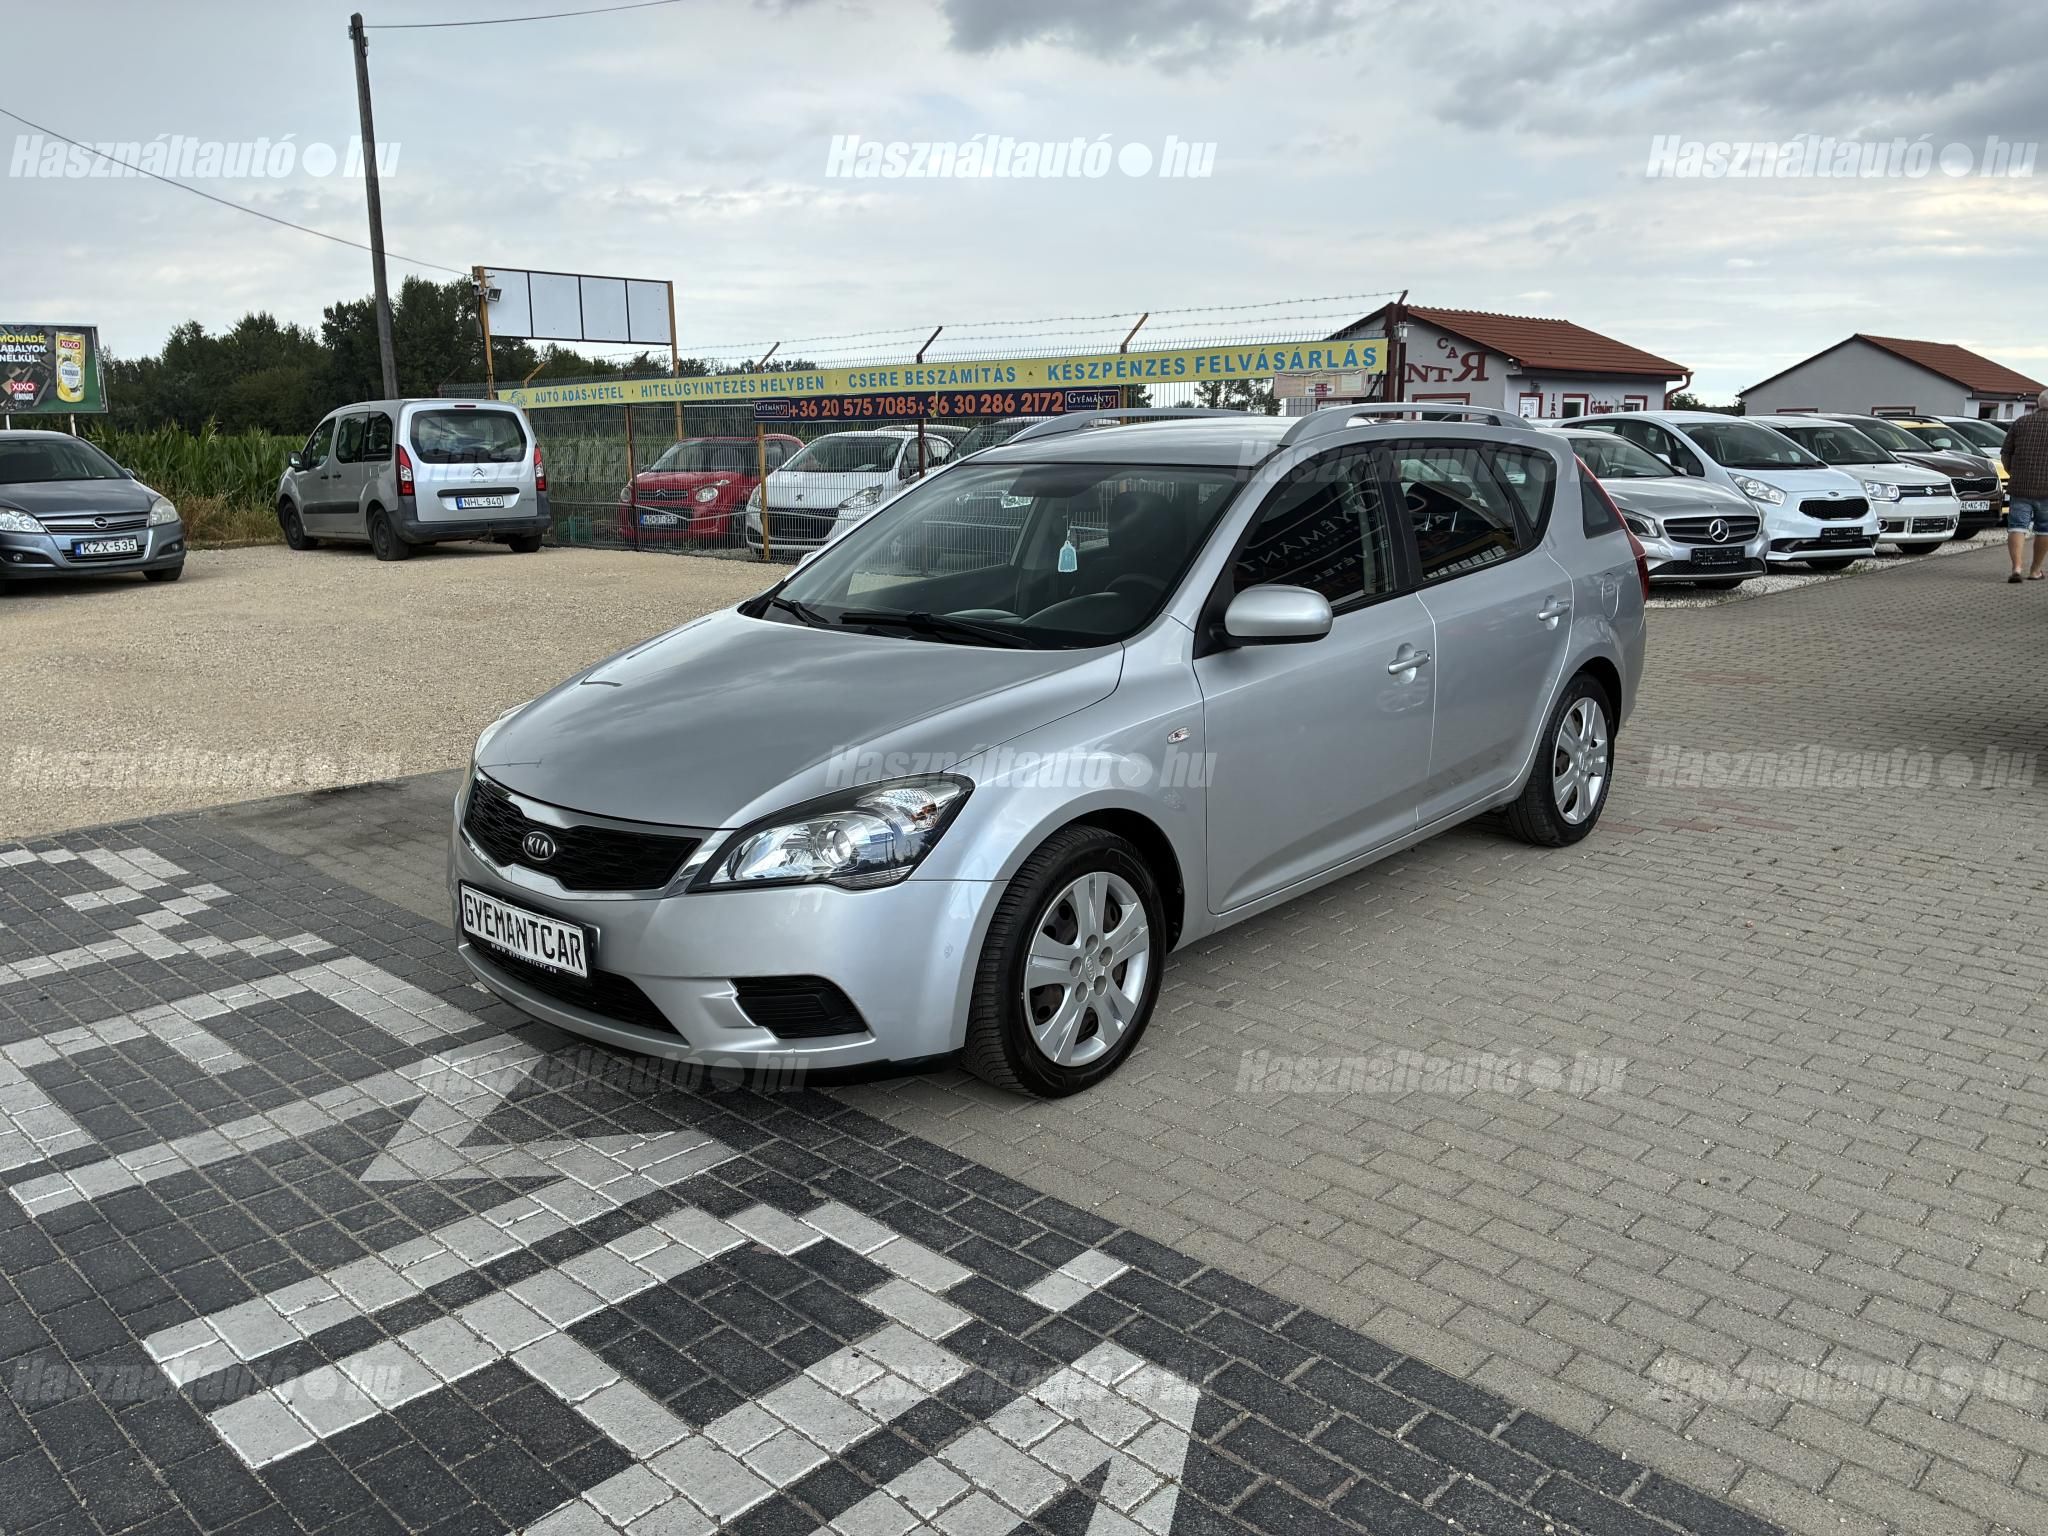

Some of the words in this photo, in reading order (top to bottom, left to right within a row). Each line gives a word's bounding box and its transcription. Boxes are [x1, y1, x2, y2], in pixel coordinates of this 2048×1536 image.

[641, 376, 756, 398] HITELÜGYINTÉZÉS
[760, 375, 824, 393] HELYBEN
[848, 371, 899, 388] CSERE
[904, 362, 1016, 386] BESZÁMÍTÁS
[1047, 356, 1185, 381] KÉSZPÉNZES
[1195, 343, 1377, 374] FELVÁSÁRLÁS
[12, 382, 35, 391] XIXO
[821, 399, 840, 417] 20
[843, 398, 873, 417] 575
[954, 394, 976, 414] 30
[980, 393, 1016, 414] 286
[1021, 391, 1064, 414] 2172
[463, 497, 502, 507] NHL-940
[83, 540, 135, 553] KZX-535
[526, 836, 549, 855] KIA
[464, 893, 584, 971] GYEMANTCAR
